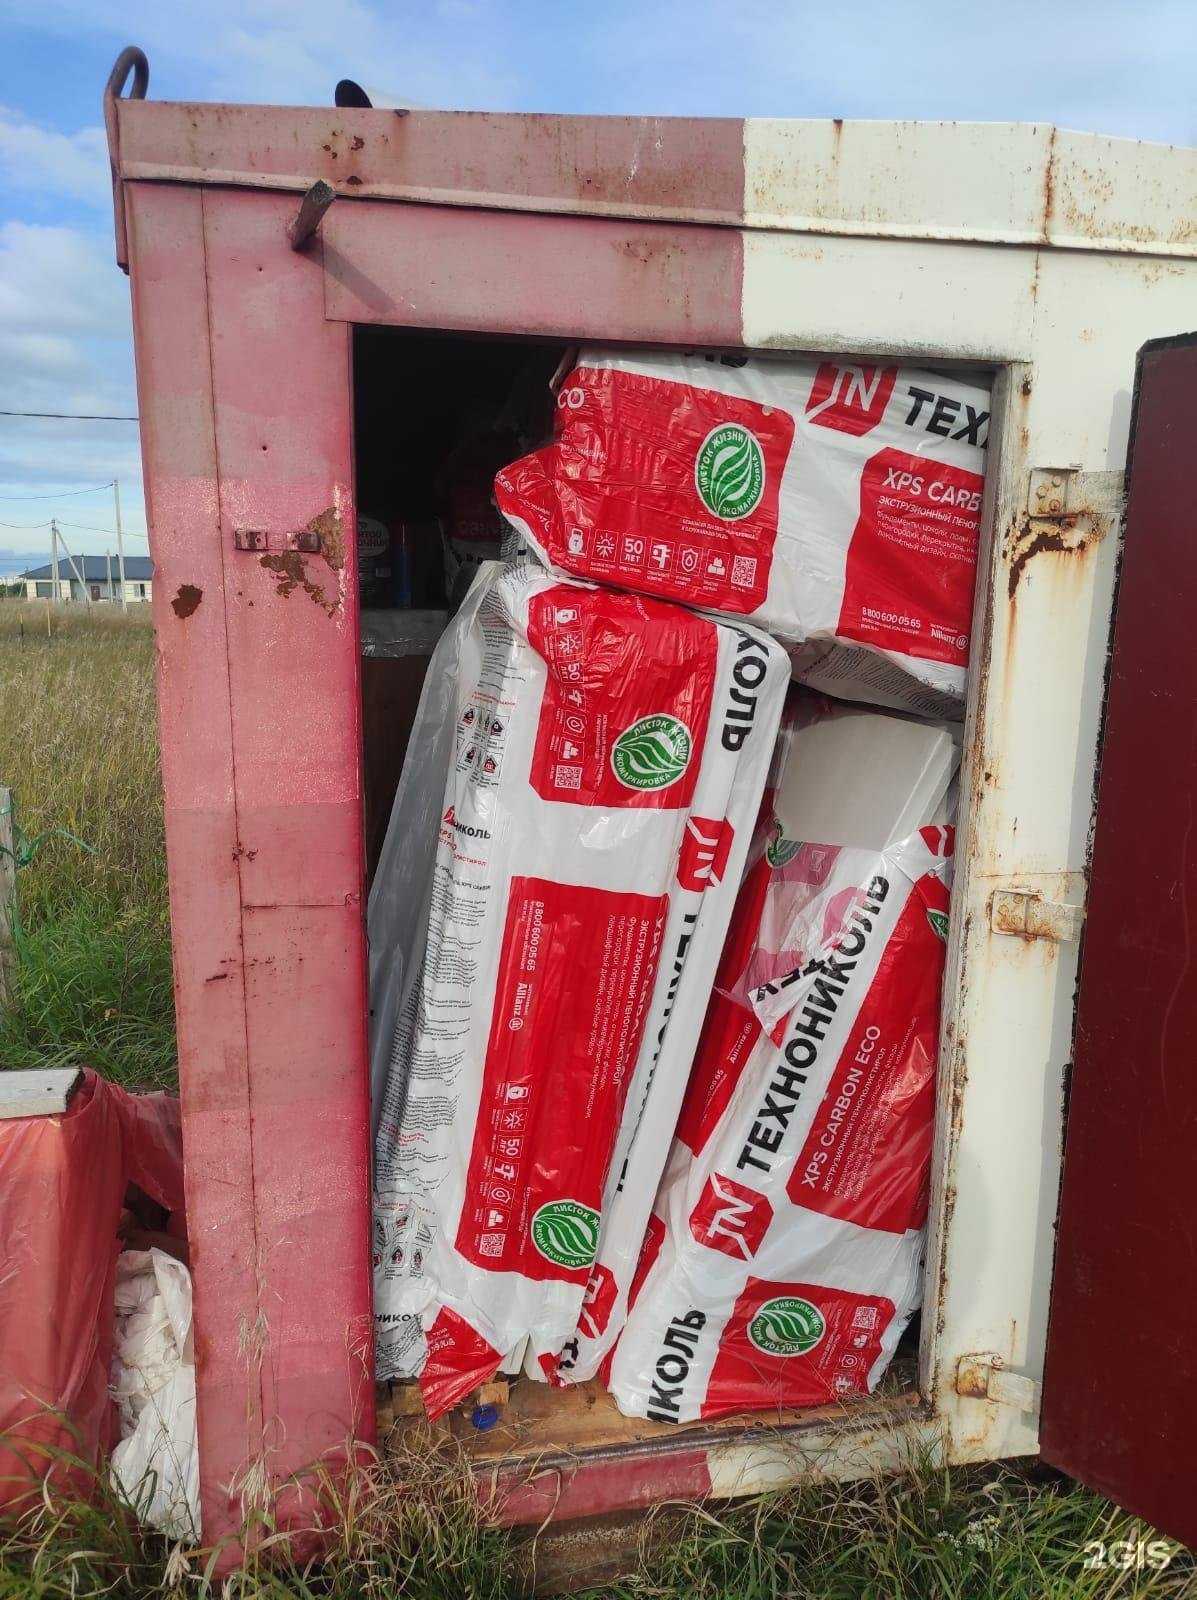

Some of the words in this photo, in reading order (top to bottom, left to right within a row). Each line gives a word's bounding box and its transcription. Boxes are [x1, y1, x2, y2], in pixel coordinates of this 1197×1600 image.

[905, 386, 988, 448] ТЕХ
[711, 430, 743, 448] ЖИЗНИ
[882, 467, 924, 495] XPS
[928, 481, 983, 511] CARB
[624, 538, 644, 554] 50
[624, 553, 641, 563] ЛЕТ
[867, 609, 881, 620] 800
[881, 612, 897, 623] 600
[931, 628, 956, 644] Allianz
[567, 662, 580, 681] 50
[616, 751, 670, 785] ЭКОМАРКИРОВКА
[532, 908, 543, 926] 800
[529, 926, 540, 945] 600
[528, 945, 537, 958] 05
[627, 919, 649, 998] ЭКСТРУЗИОННЫЙ
[526, 959, 535, 970] 65
[513, 982, 527, 1017] Allianz
[737, 876, 890, 1172] ТЕХНОНИКОЛЬ
[612, 1000, 634, 1085] ПЕНОПОЛИСТИРОЛ
[800, 1148, 828, 1189] XPS
[818, 1066, 863, 1148] CARBON
[854, 1023, 882, 1065] ECO
[821, 1120, 854, 1192] ЭКСТРУЗИОННЫЙ
[849, 1047, 886, 1121] ПЕНОПОЛИСТИРОЛ
[507, 1137, 520, 1157] 50
[553, 1204, 590, 1219] ЛИСТОК
